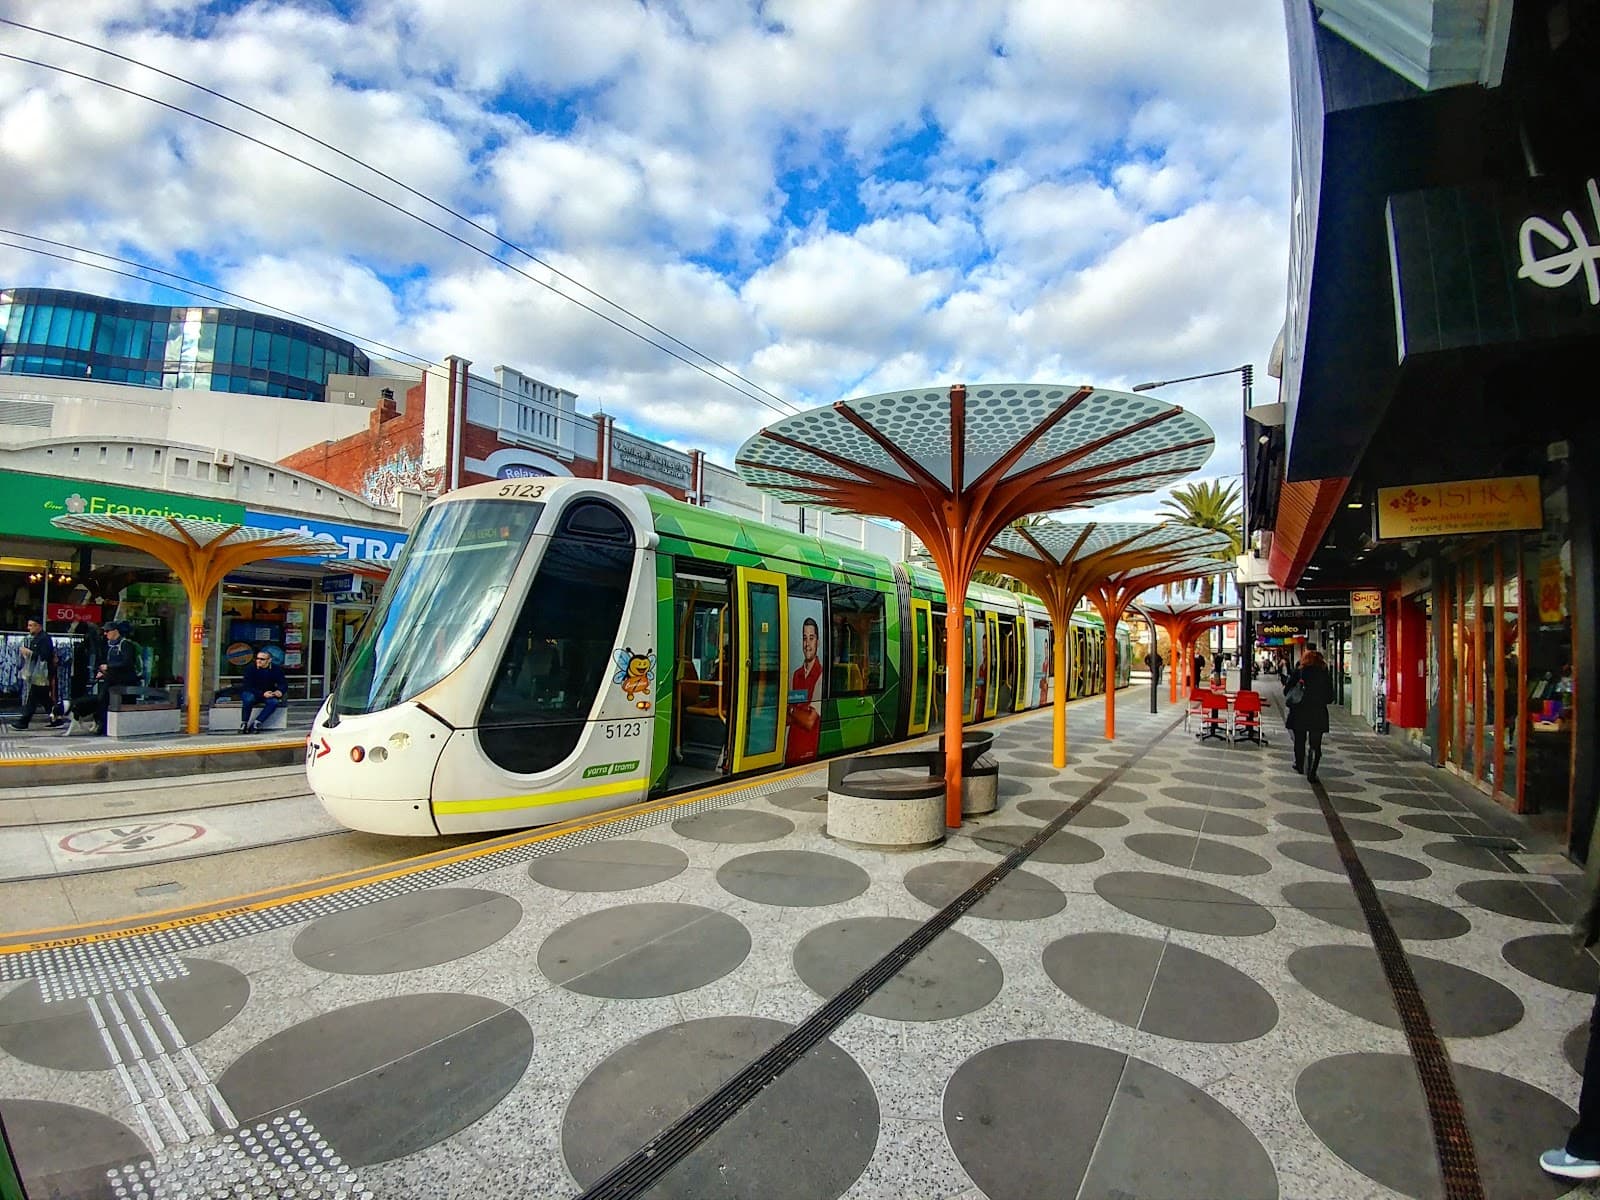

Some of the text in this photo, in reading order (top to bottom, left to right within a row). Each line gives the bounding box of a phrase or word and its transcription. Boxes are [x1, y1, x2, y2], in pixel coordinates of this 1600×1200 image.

[498, 484, 545, 498] 5123
[1438, 481, 1529, 509] ISHKA
[605, 722, 641, 739] 5123
[587, 762, 636, 778] yarra trams
[29, 936, 88, 950] STAND
[94, 925, 160, 941] BEHIND
[168, 914, 209, 928] THIS
